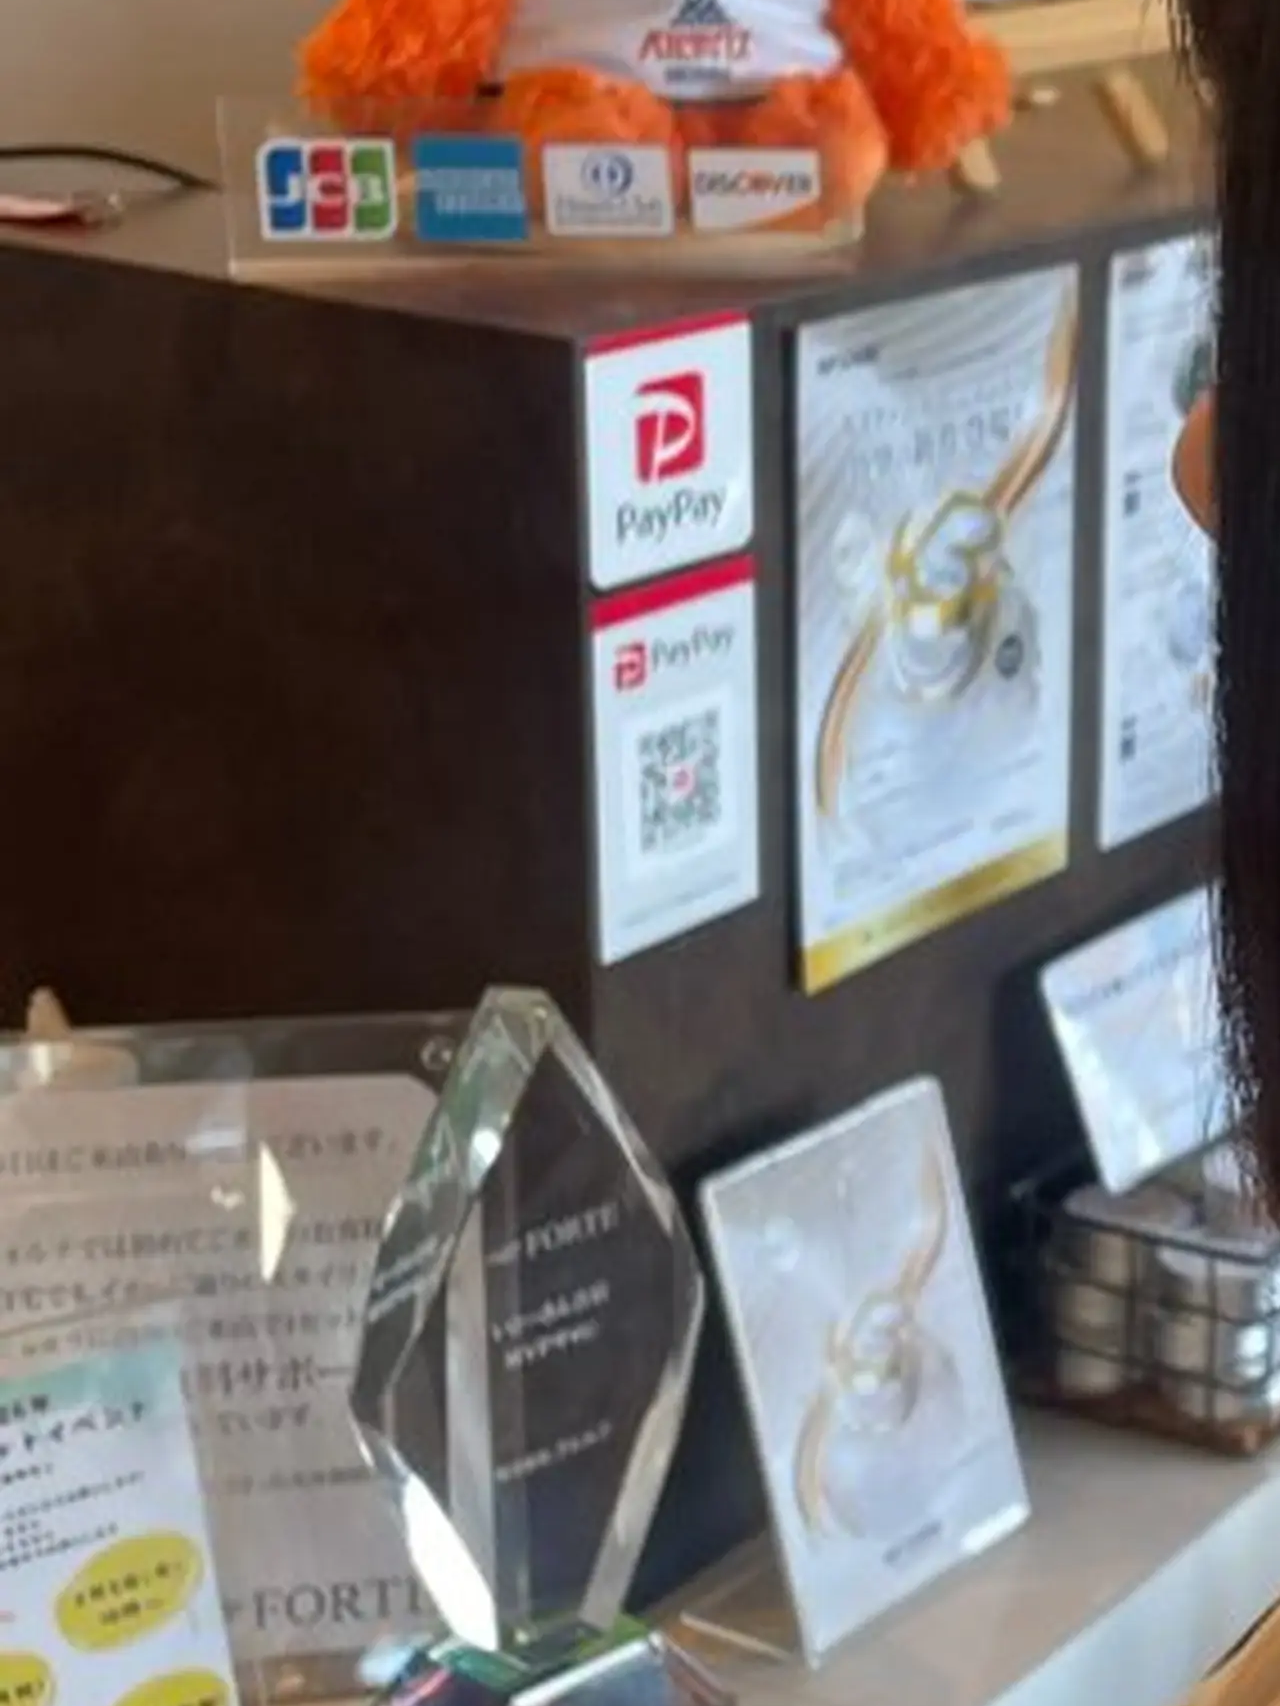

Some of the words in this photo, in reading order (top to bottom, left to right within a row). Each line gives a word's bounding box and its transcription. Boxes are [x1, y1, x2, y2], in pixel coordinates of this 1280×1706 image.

[694, 169, 813, 196] DISCOVER
[616, 487, 727, 545] PayPay
[651, 624, 736, 672] PayPay
